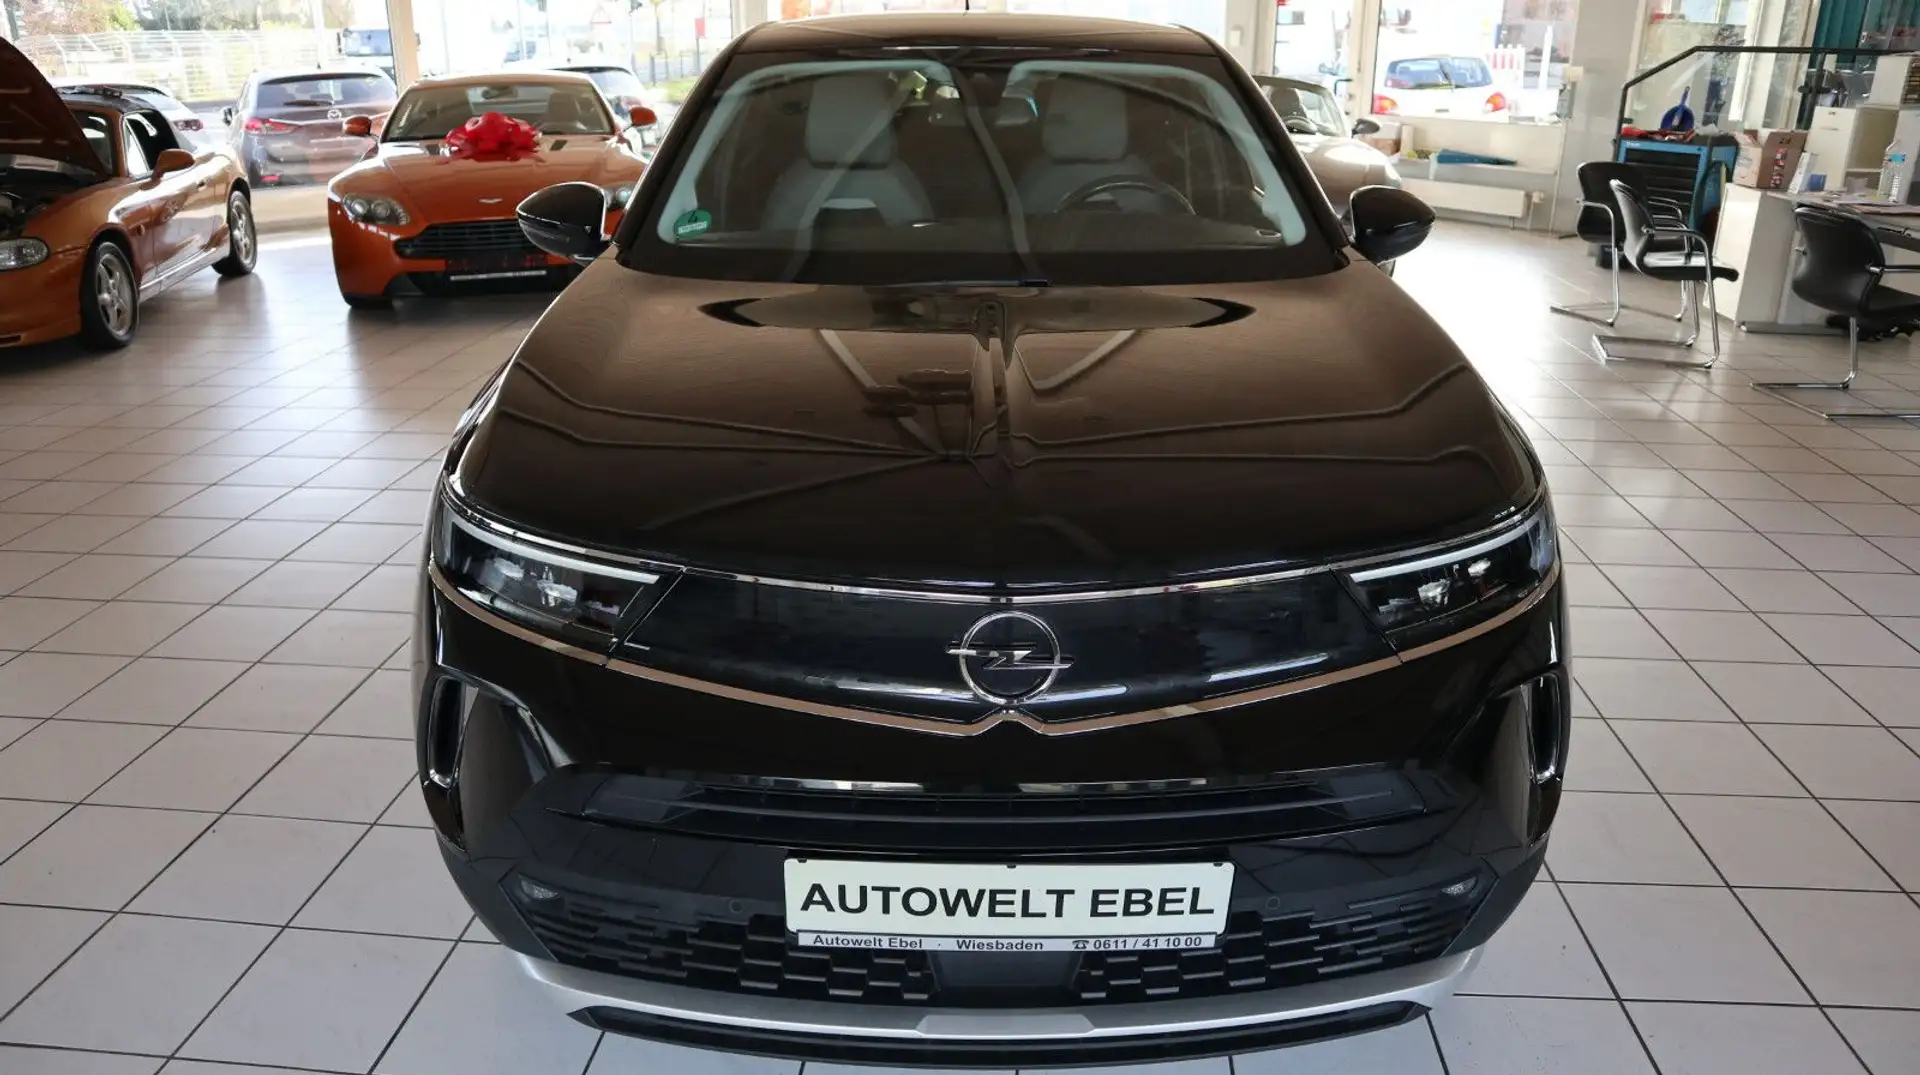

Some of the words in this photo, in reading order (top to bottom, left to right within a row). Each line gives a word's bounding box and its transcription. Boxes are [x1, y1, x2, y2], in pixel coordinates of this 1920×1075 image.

[800, 883, 1075, 918] AUTOWELT
[1090, 887, 1214, 917] EBEL
[813, 935, 883, 947] Autowelt
[888, 937, 922, 949] Ebel
[956, 939, 1043, 950] Wiesbaden
[1093, 939, 1127, 949] 0611
[1142, 938, 1158, 948] 41
[1165, 937, 1181, 947] 10
[1185, 936, 1202, 947] 00
